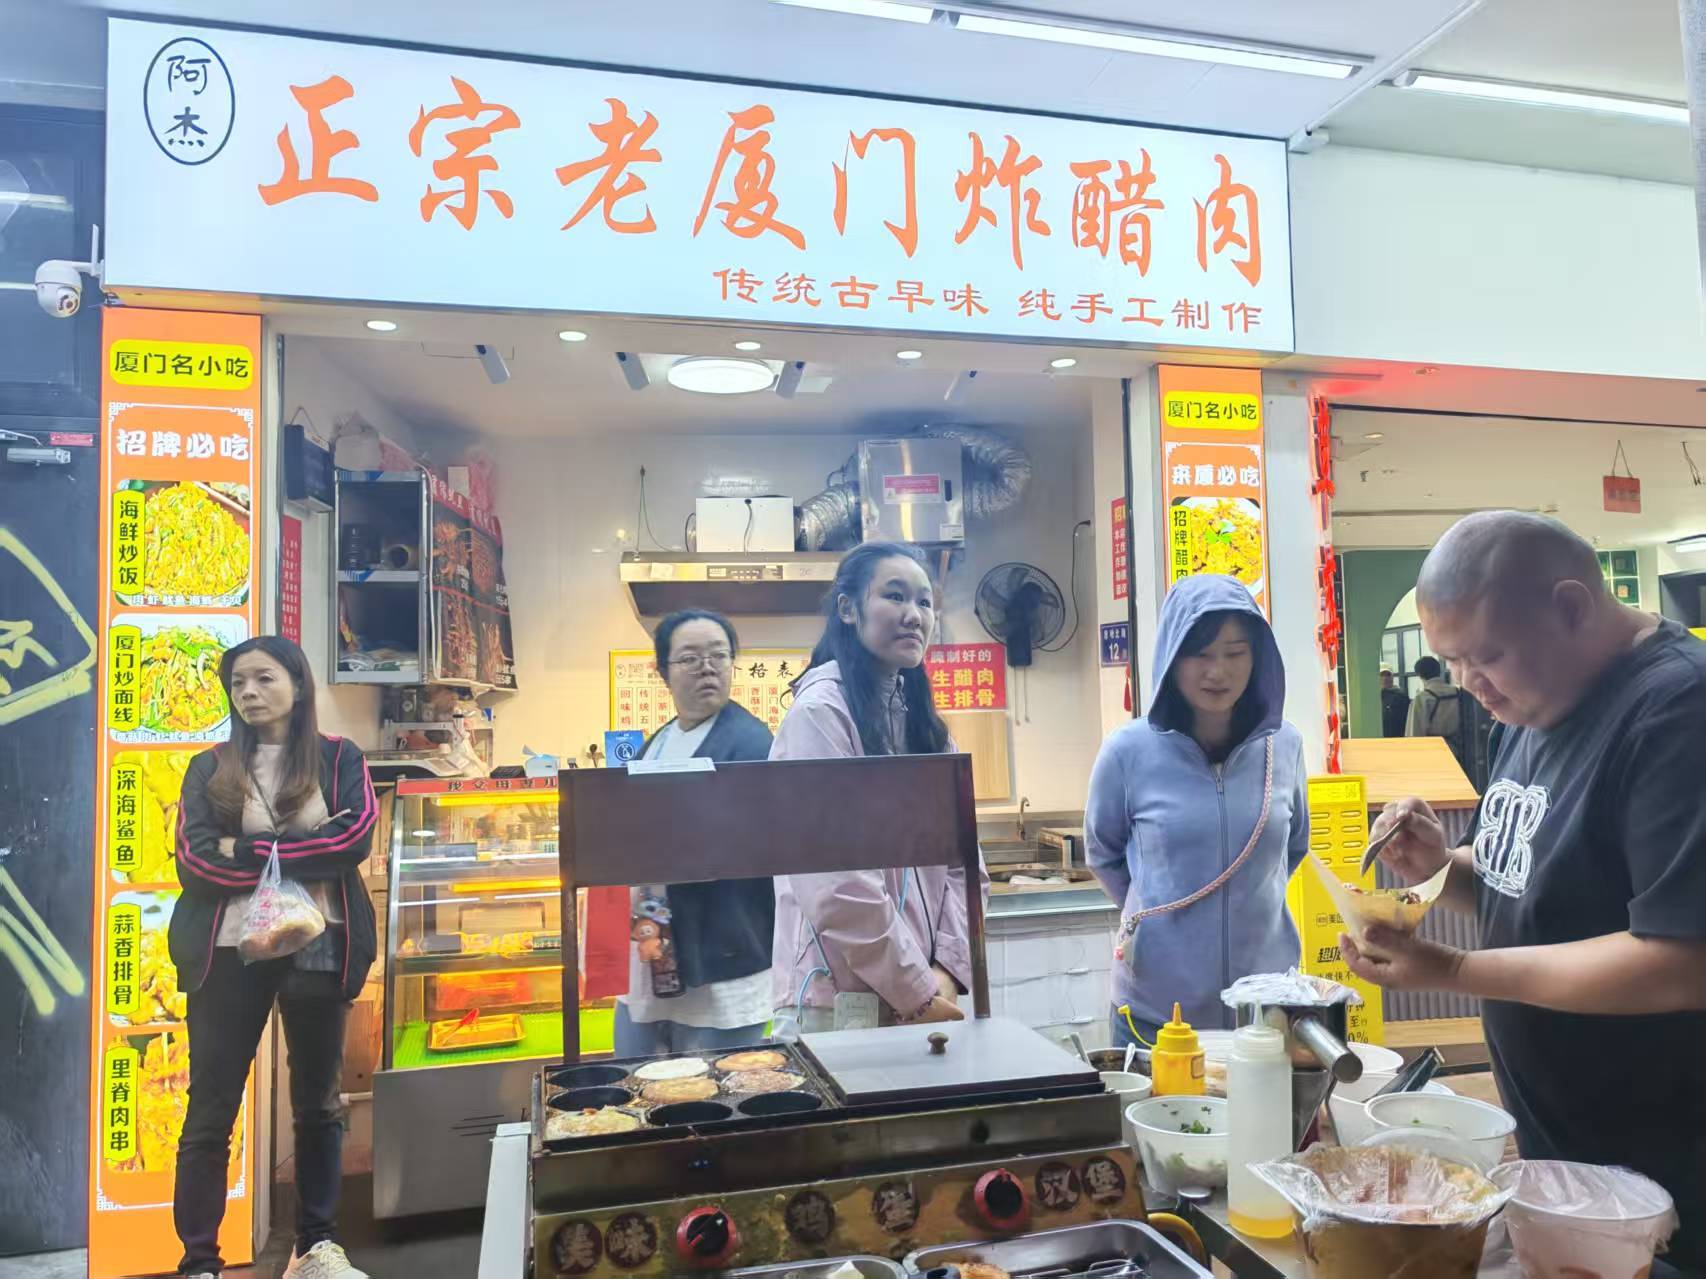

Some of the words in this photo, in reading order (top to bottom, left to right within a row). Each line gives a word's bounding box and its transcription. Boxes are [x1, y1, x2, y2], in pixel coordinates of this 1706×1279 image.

[164, 55, 211, 148] 阿杰
[258, 75, 1262, 288] 正宗老厦门炸醋肉
[712, 268, 990, 316] 传统古早味
[1017, 288, 1262, 333] 纯手工制作
[114, 350, 249, 379] 厦门名小吃
[116, 429, 250, 459] 招牌必吃
[1167, 399, 1257, 421] 厦门名小吃
[119, 500, 139, 586] 海鲜炒饭
[1173, 510, 1188, 579] 招牌醋肉
[114, 635, 134, 723] 厦门炒面线
[932, 667, 994, 688] 生醋肉
[1109, 642, 1120, 660] 12
[933, 688, 995, 709] 生排骨
[116, 769, 136, 866] 深海鲨鱼
[113, 914, 135, 1006] 蒜香排骨
[110, 1057, 131, 1152] 里脊肉串
